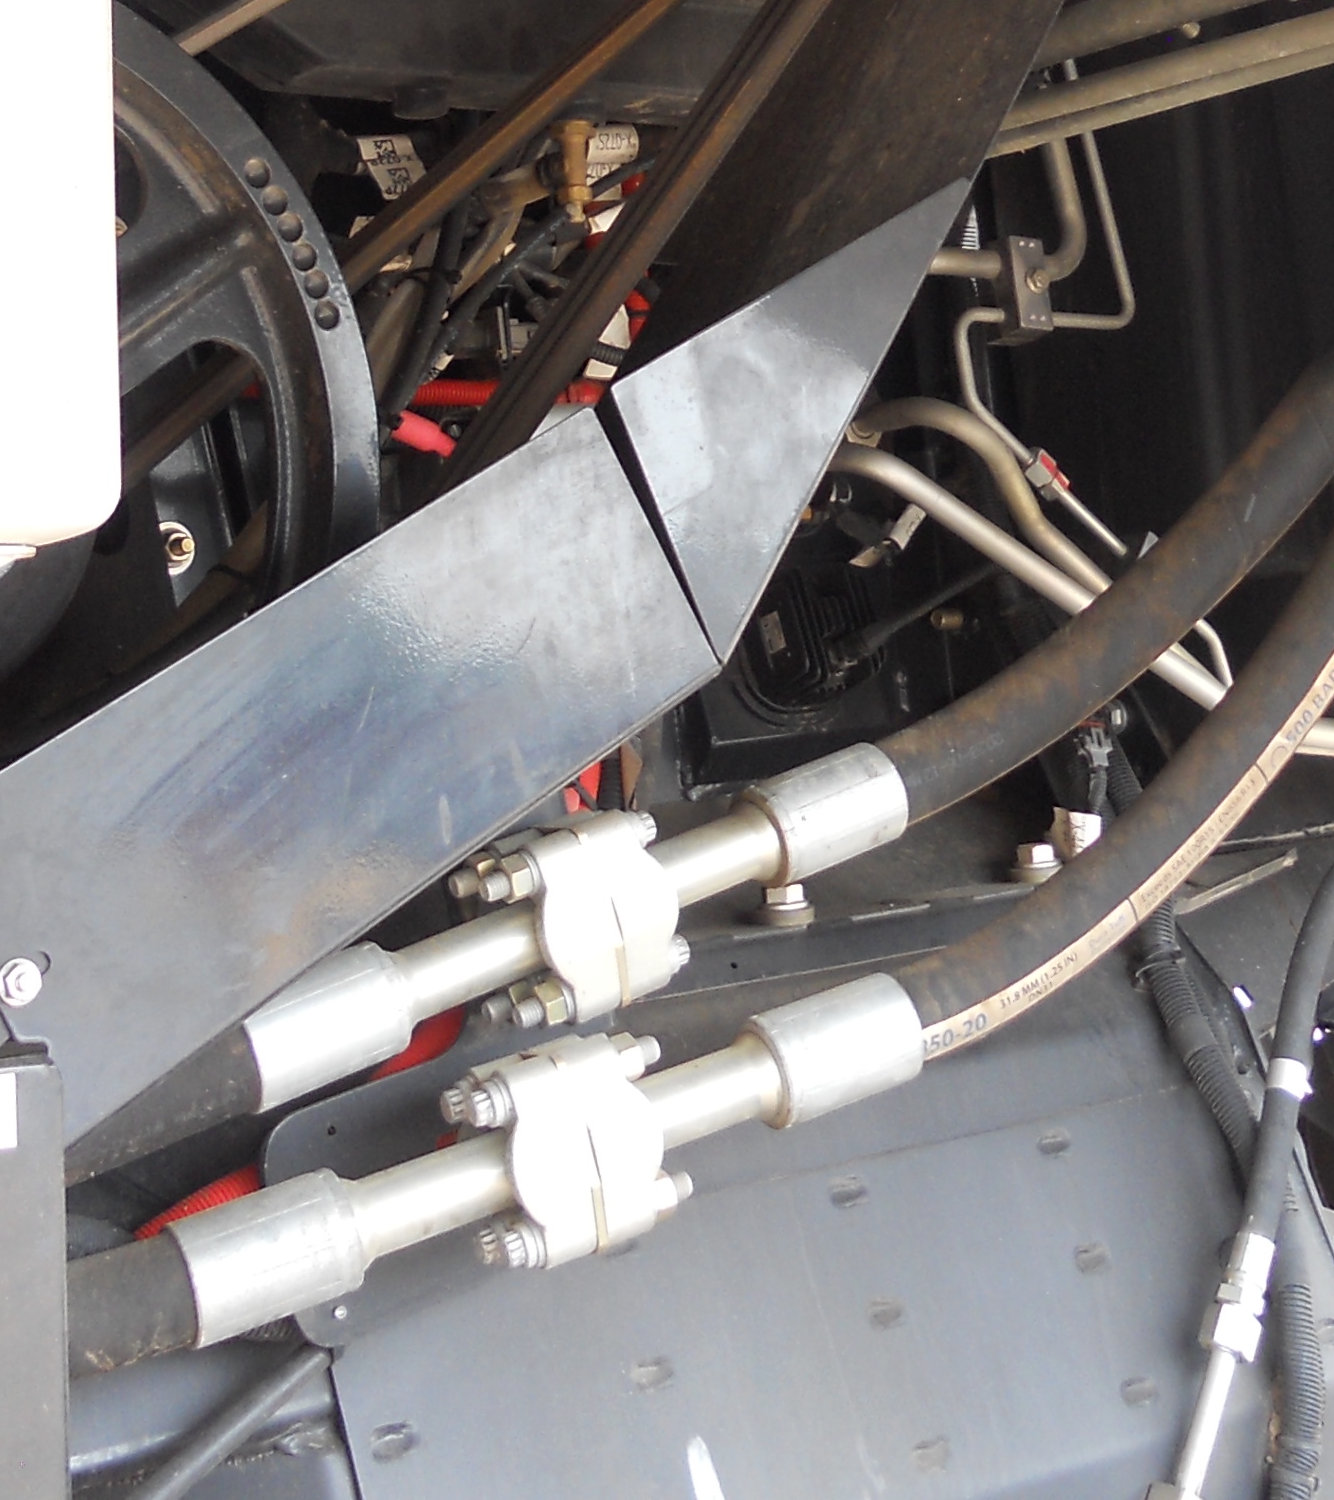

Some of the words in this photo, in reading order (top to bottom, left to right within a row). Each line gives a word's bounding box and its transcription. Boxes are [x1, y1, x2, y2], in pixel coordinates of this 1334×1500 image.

[1283, 706, 1315, 746] 500
[1138, 867, 1173, 904] Exceeds
[997, 990, 1022, 1010] 31.8
[1018, 977, 1041, 996] MM
[1037, 962, 1065, 984] (1.25
[1061, 951, 1080, 967] IN)
